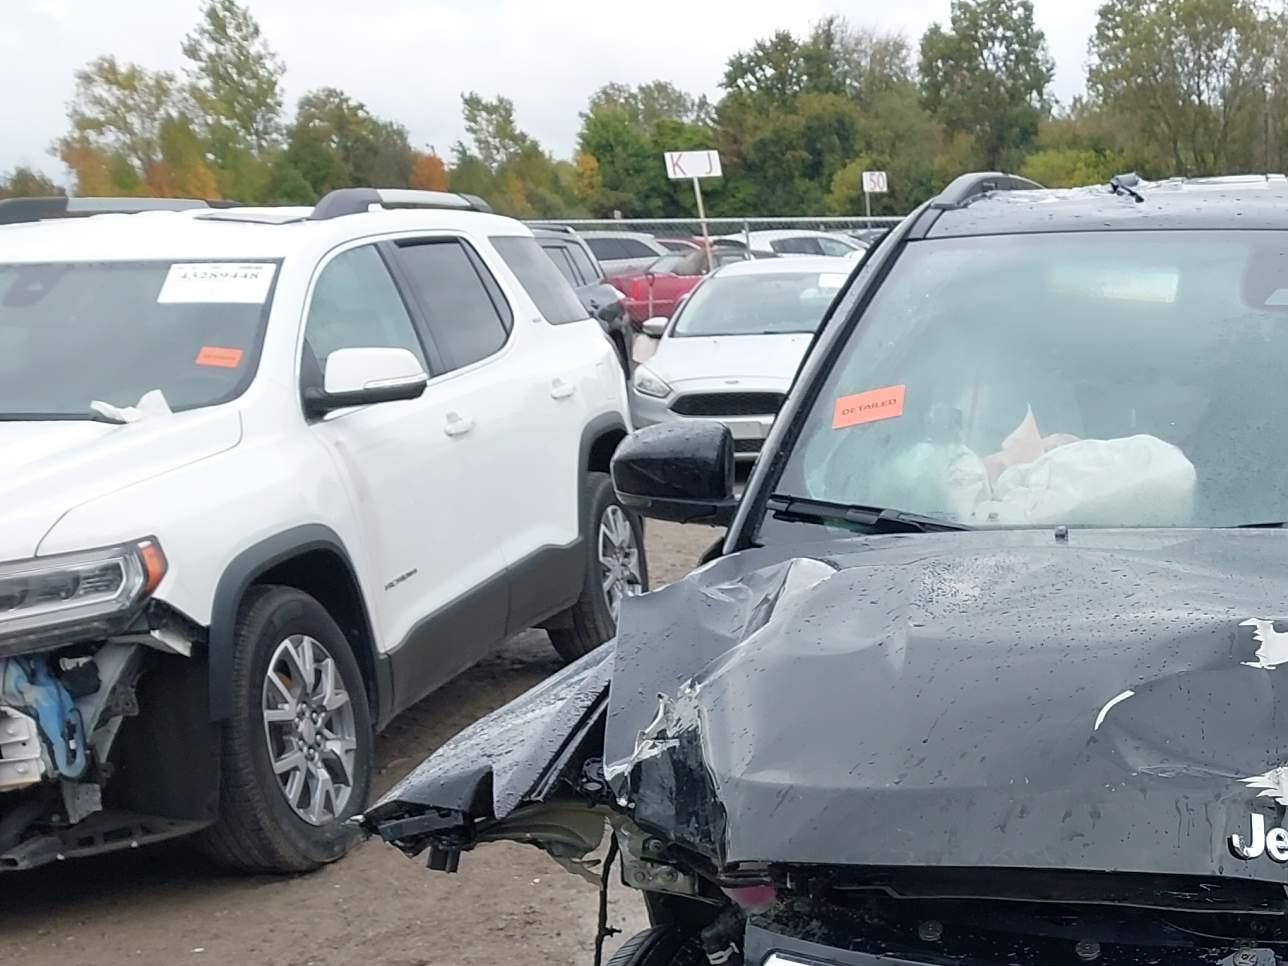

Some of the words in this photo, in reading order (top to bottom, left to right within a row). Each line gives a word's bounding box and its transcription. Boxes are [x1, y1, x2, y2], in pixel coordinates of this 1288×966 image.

[670, 153, 687, 176] K
[705, 153, 713, 174] J
[841, 398, 897, 416] DETAILED
